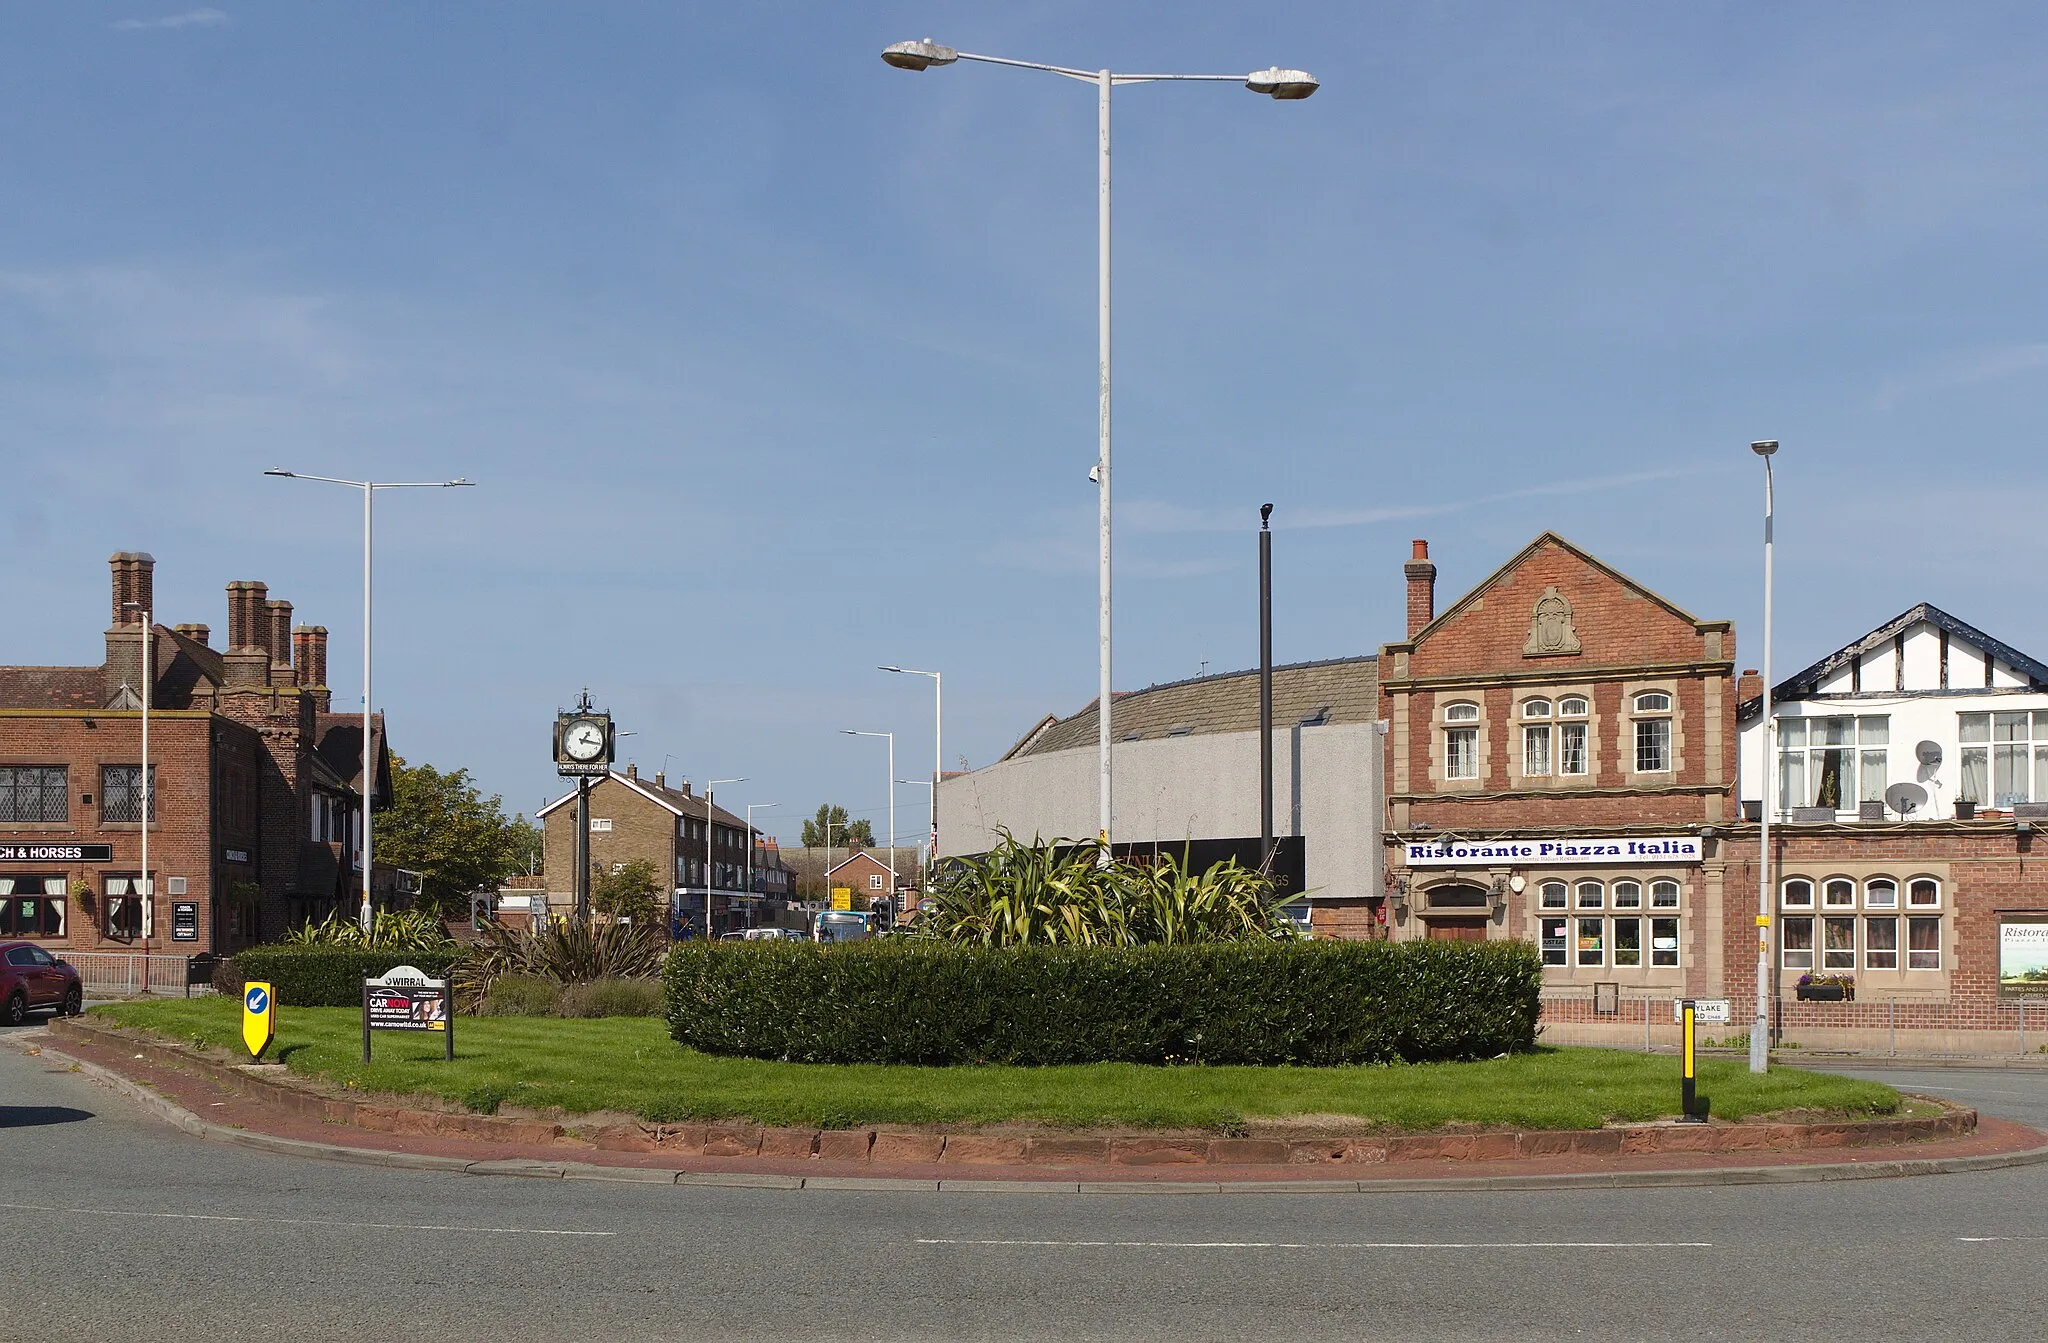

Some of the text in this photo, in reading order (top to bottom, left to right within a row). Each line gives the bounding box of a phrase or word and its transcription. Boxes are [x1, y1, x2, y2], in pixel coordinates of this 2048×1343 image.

[18, 847, 26, 858] &
[30, 847, 82, 858] HORSES
[1410, 841, 1695, 858] Ristorante Piazza Italia
[392, 978, 426, 986] WIRRAL
[370, 999, 409, 1008] CARNOW
